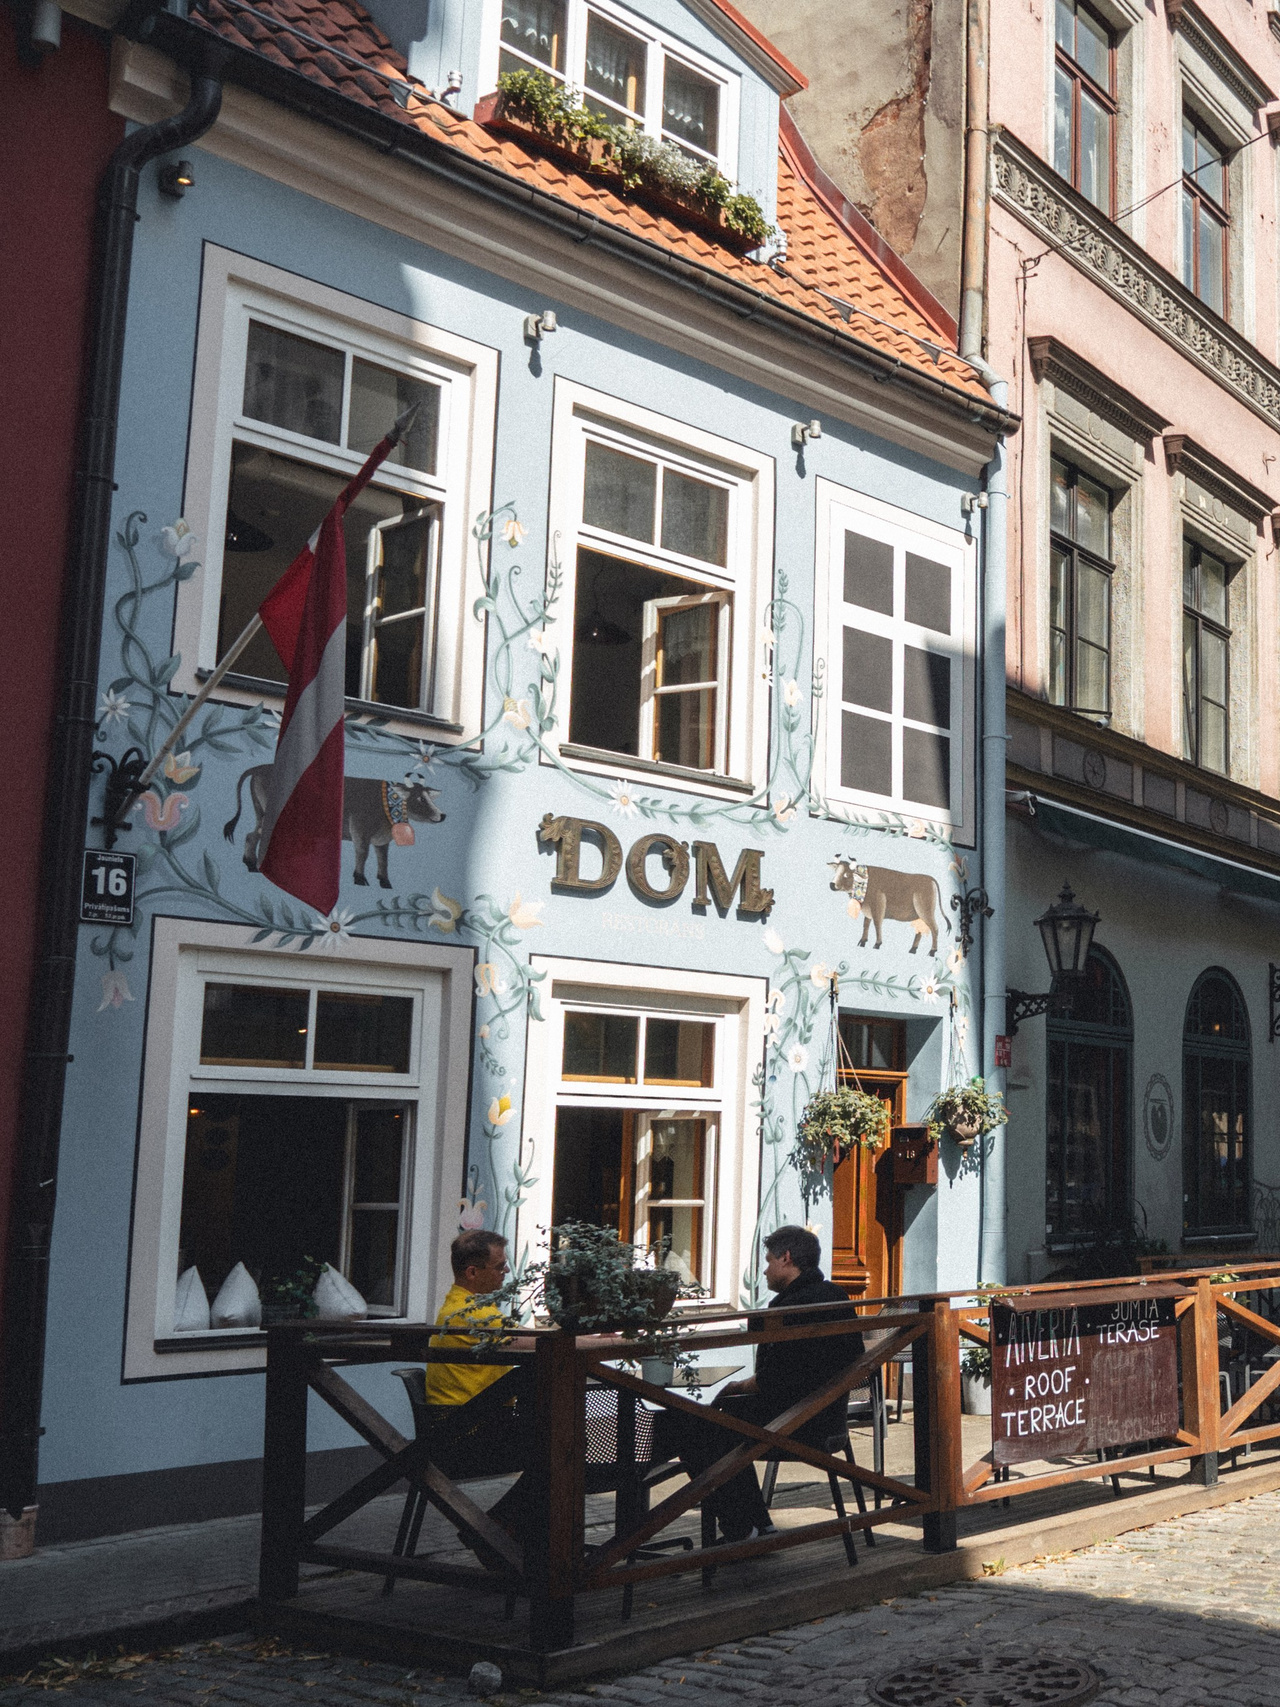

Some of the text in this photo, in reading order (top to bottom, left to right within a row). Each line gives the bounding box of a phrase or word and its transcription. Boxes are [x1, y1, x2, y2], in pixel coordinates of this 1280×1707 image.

[537, 812, 776, 914] DOM
[91, 866, 127, 896] 16
[1096, 1319, 1160, 1344] TERASE
[1025, 1366, 1076, 1400] ROOF
[1001, 1398, 1086, 1437] TERRACE
